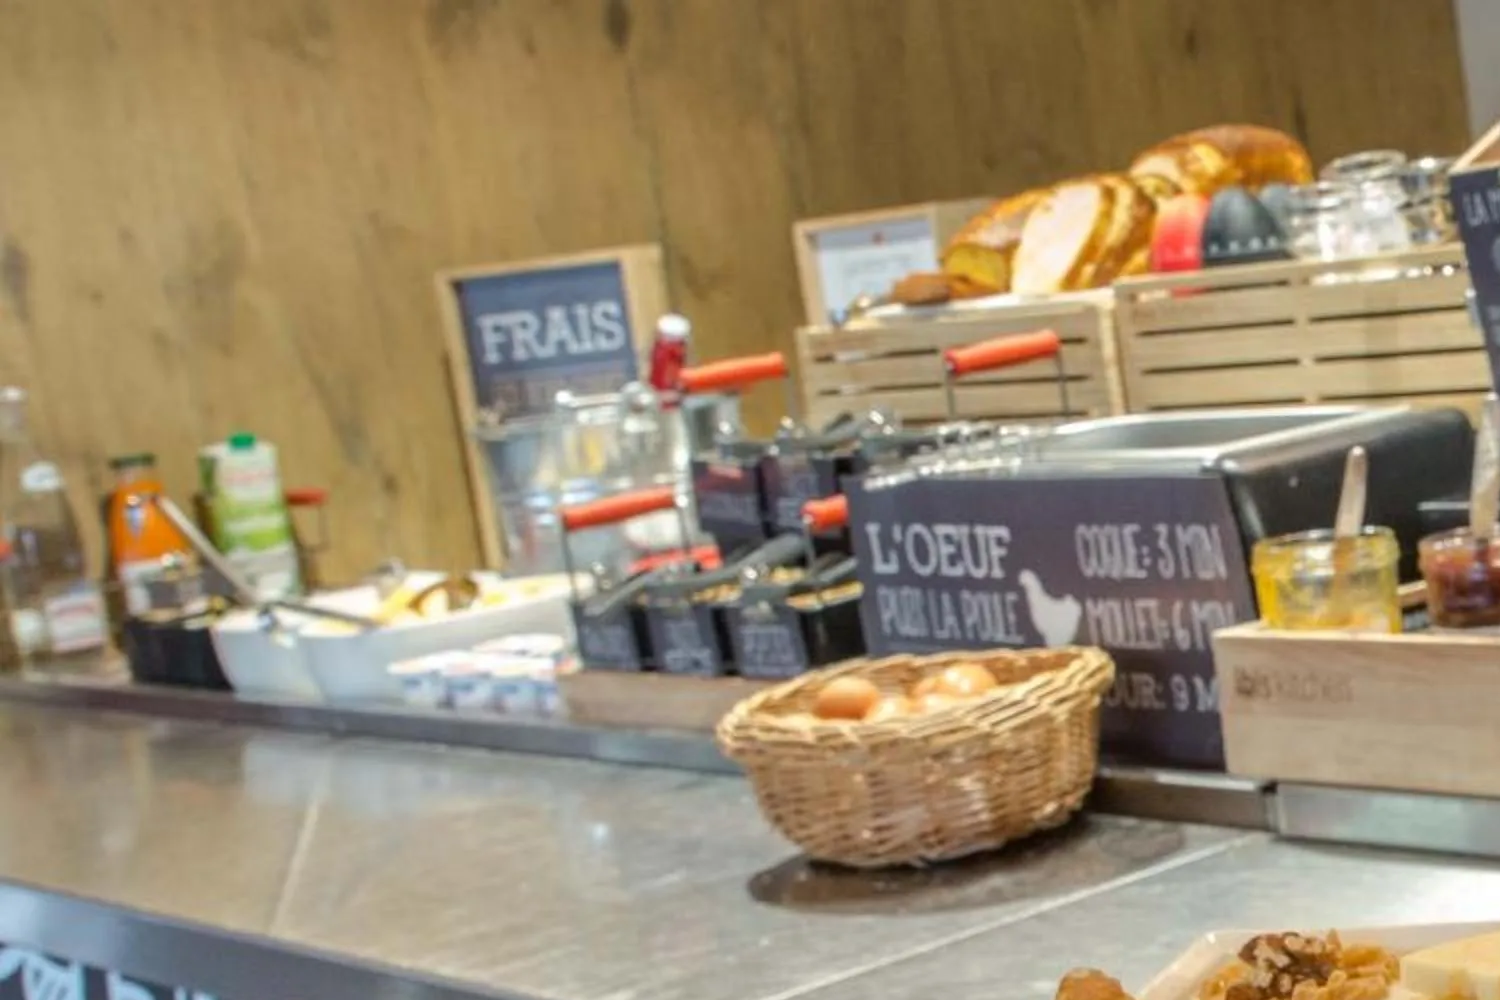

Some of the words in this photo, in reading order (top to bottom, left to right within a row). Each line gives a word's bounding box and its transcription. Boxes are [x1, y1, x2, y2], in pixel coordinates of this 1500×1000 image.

[476, 300, 627, 364] FRAIS
[865, 522, 1012, 580] L'OEUF
[1154, 522, 1176, 579] 3
[1171, 599, 1192, 651] 6
[1170, 673, 1190, 712] 9
